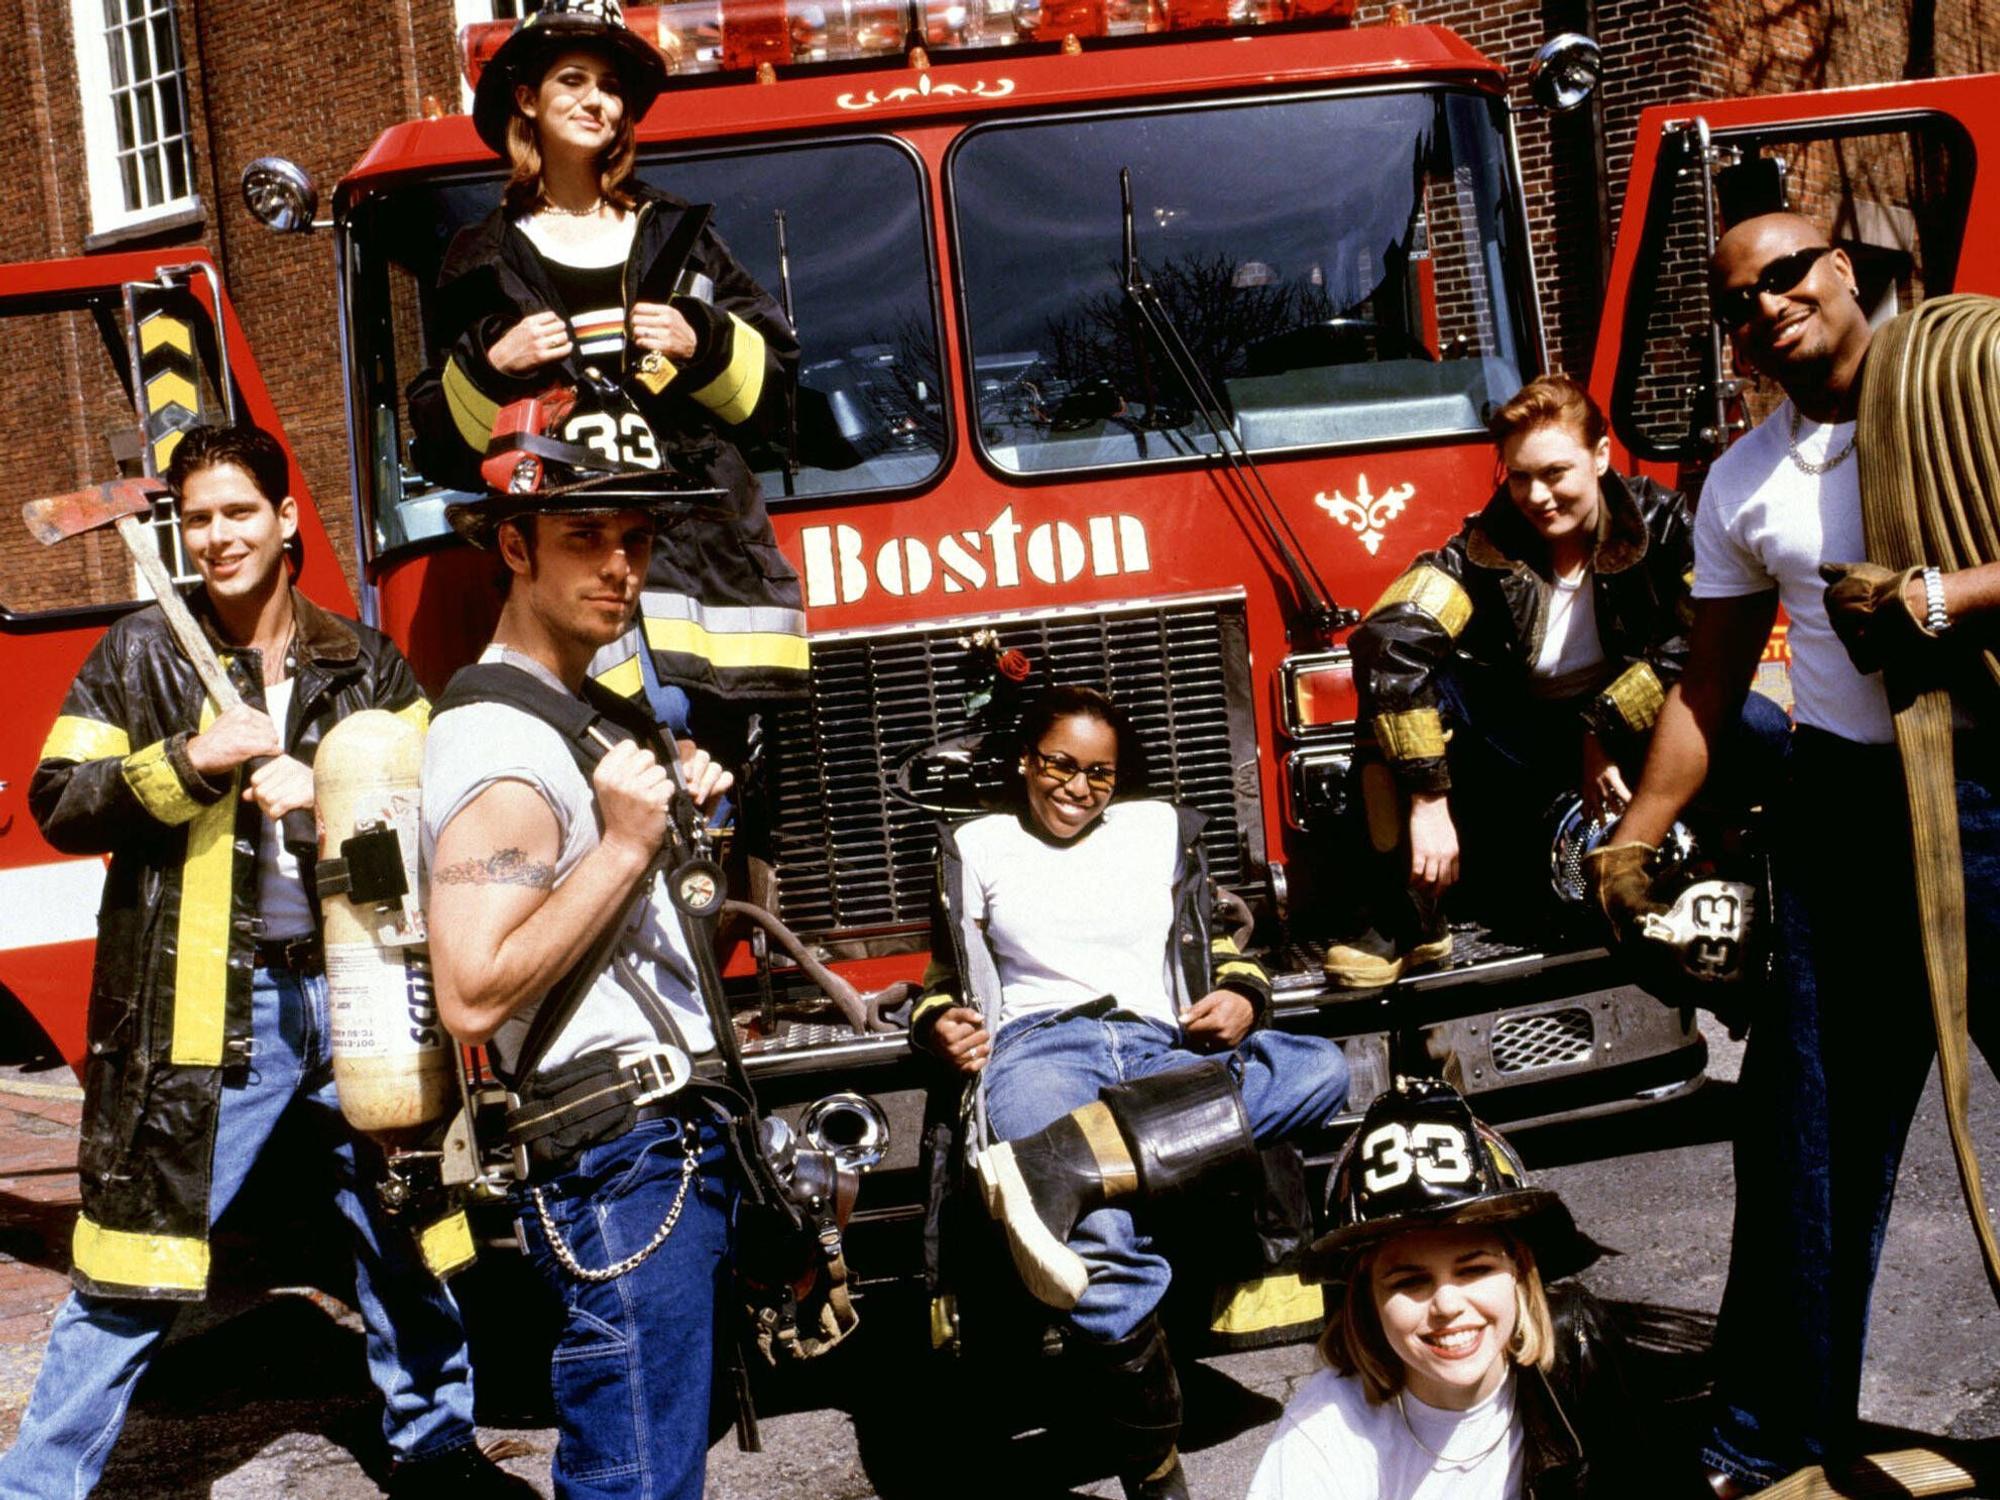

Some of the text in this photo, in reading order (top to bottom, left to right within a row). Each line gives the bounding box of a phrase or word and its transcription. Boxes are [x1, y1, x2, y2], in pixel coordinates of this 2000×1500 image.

[564, 410, 661, 470] 33
[801, 502, 1151, 608] Boston
[1362, 1122, 1472, 1194] 33
